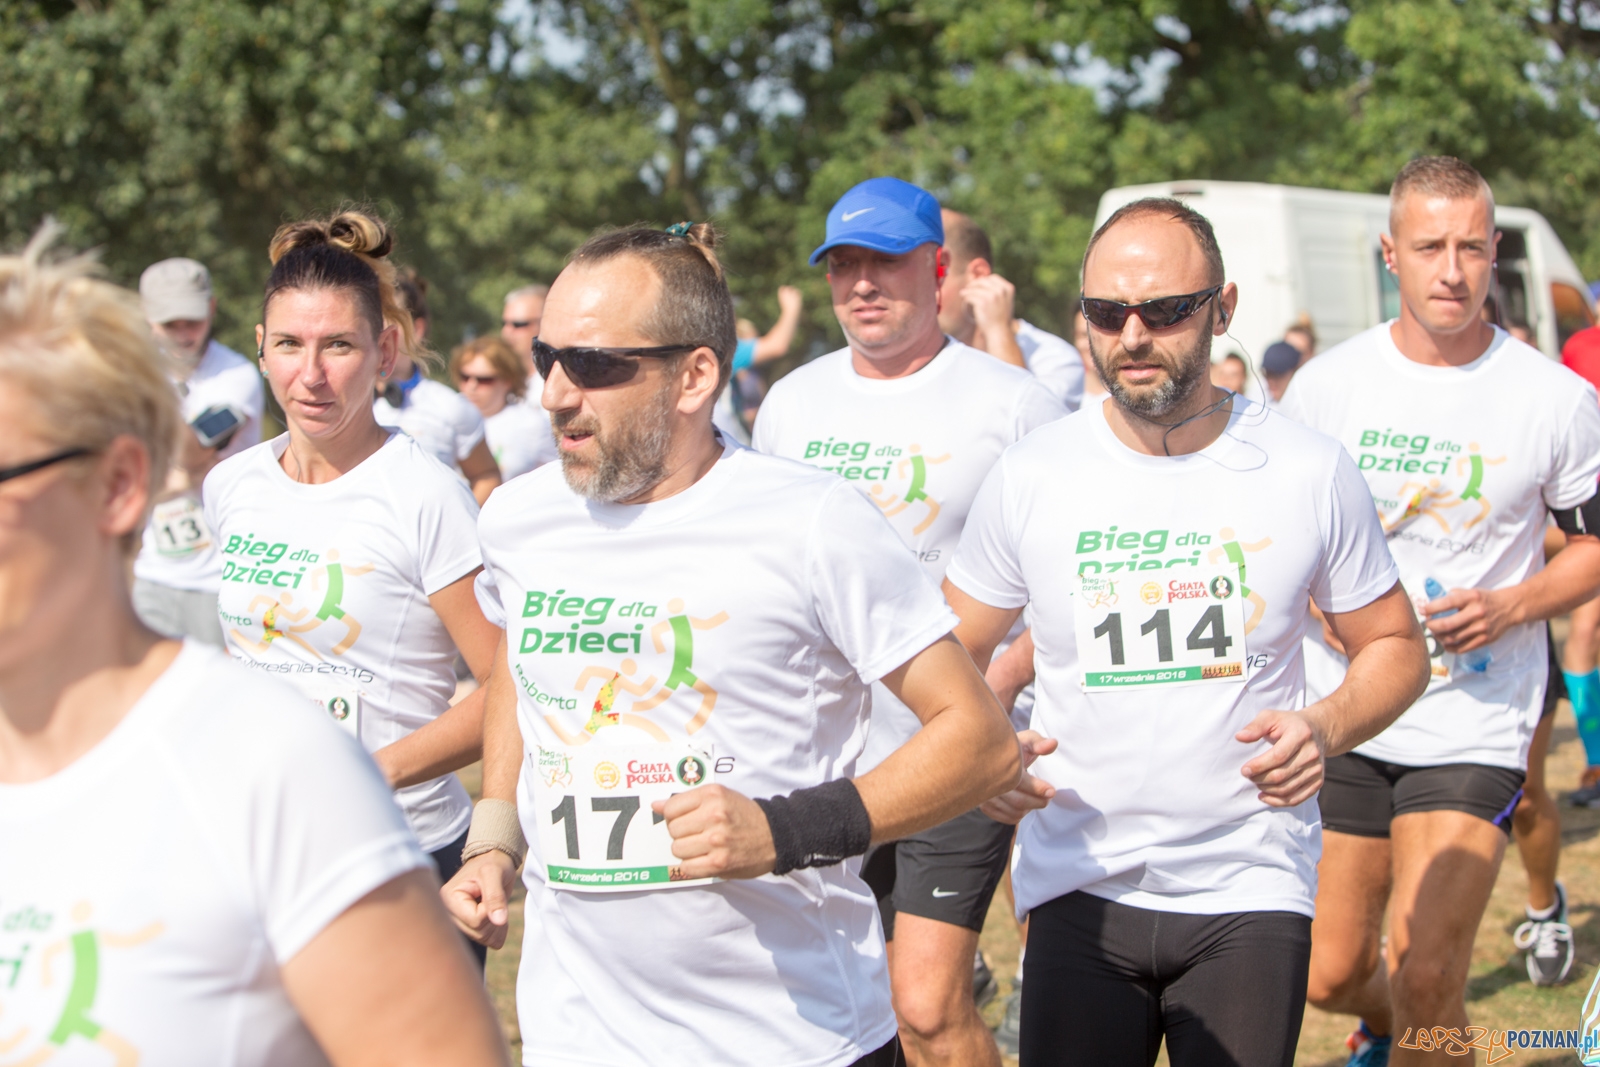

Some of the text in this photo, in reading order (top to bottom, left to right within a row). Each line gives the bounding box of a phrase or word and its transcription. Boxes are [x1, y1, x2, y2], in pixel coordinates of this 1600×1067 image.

[804, 437, 902, 461] Bieg dla
[1359, 428, 1462, 455] Bieg dla
[1358, 453, 1452, 475] Dzieci
[163, 519, 202, 545] 13
[1075, 525, 1212, 555] Bieg dla
[224, 533, 319, 564] Bieg dla
[222, 561, 306, 589] Dzieci
[521, 589, 658, 625] Bieg dla
[519, 623, 644, 654] Dzieci
[1094, 604, 1233, 665] 114
[515, 663, 577, 710] Roberta
